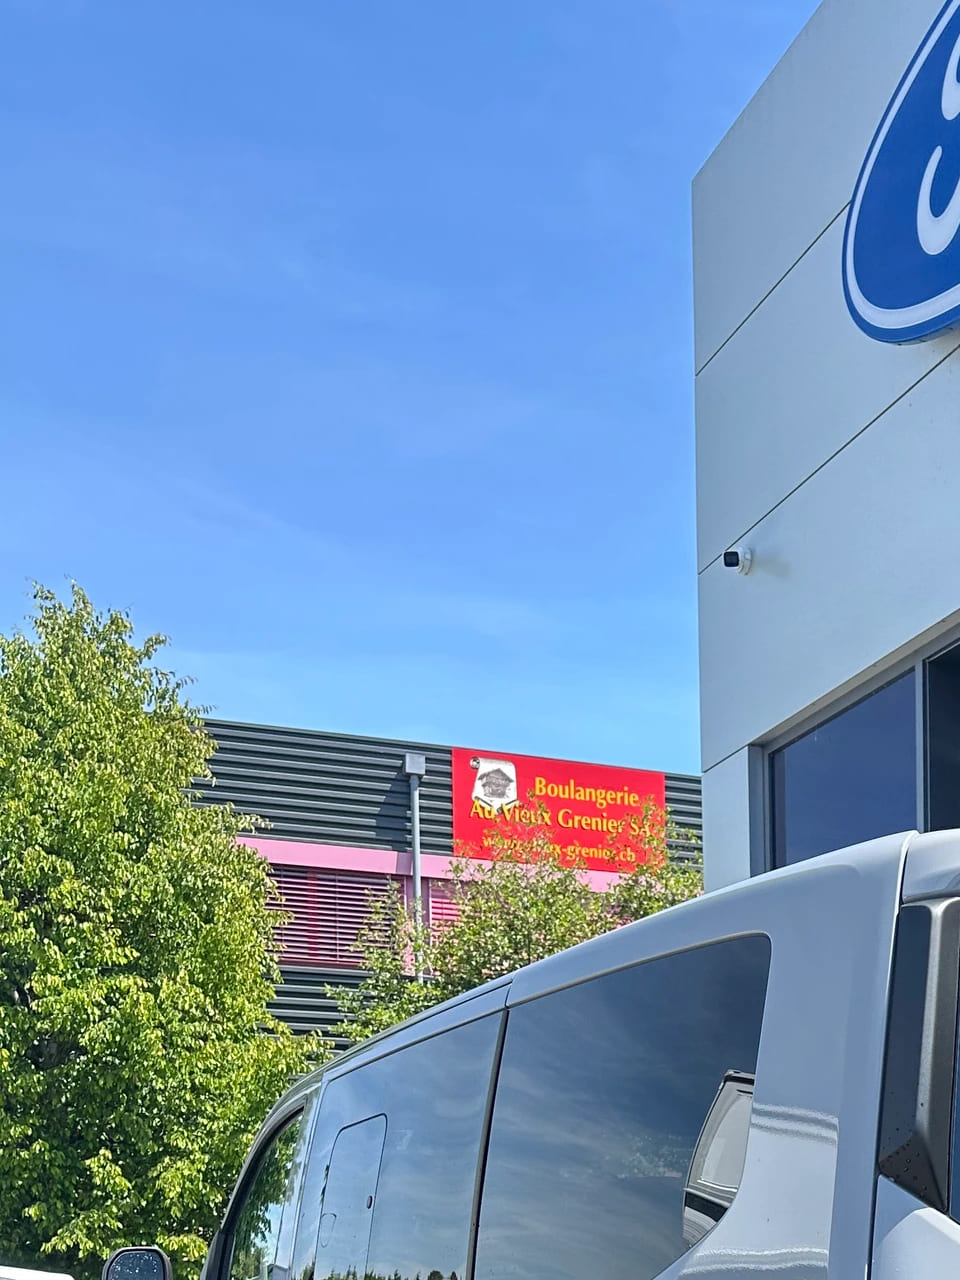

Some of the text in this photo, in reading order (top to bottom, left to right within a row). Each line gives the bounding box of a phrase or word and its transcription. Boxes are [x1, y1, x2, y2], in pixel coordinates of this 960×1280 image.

[535, 777, 639, 808] Boulangerie
[470, 800, 496, 820] Au
[502, 802, 552, 826] Vieux
[557, 808, 624, 834] Grenier
